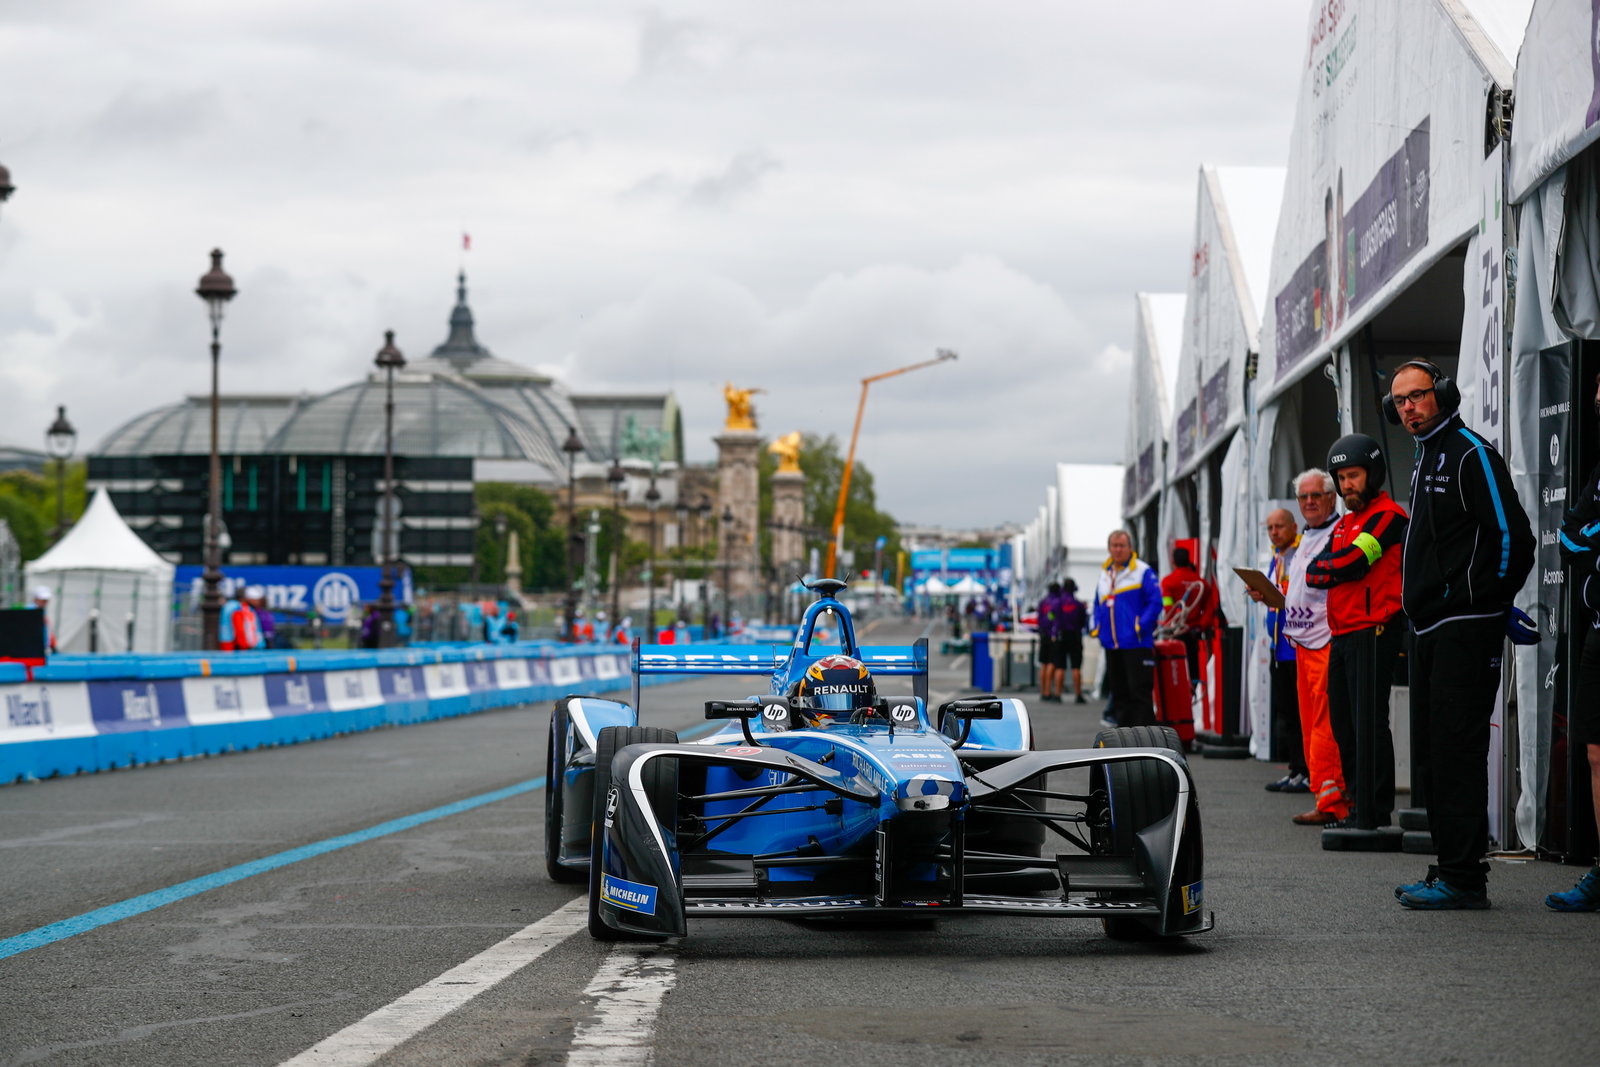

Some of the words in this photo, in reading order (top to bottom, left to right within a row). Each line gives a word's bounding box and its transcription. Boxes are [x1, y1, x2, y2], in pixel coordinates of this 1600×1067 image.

[1482, 249, 1490, 423] FAN
[1540, 405, 1558, 418] RICHARD
[1558, 401, 1570, 413] MILLE
[1543, 568, 1564, 585] Acronis
[640, 654, 908, 669] RENT
[814, 684, 869, 696] RENAULT
[767, 704, 785, 720] hp
[895, 705, 913, 721] hp
[852, 751, 873, 782] RICHARD
[873, 770, 889, 796] MILLE
[609, 885, 649, 905] MICHELIN
